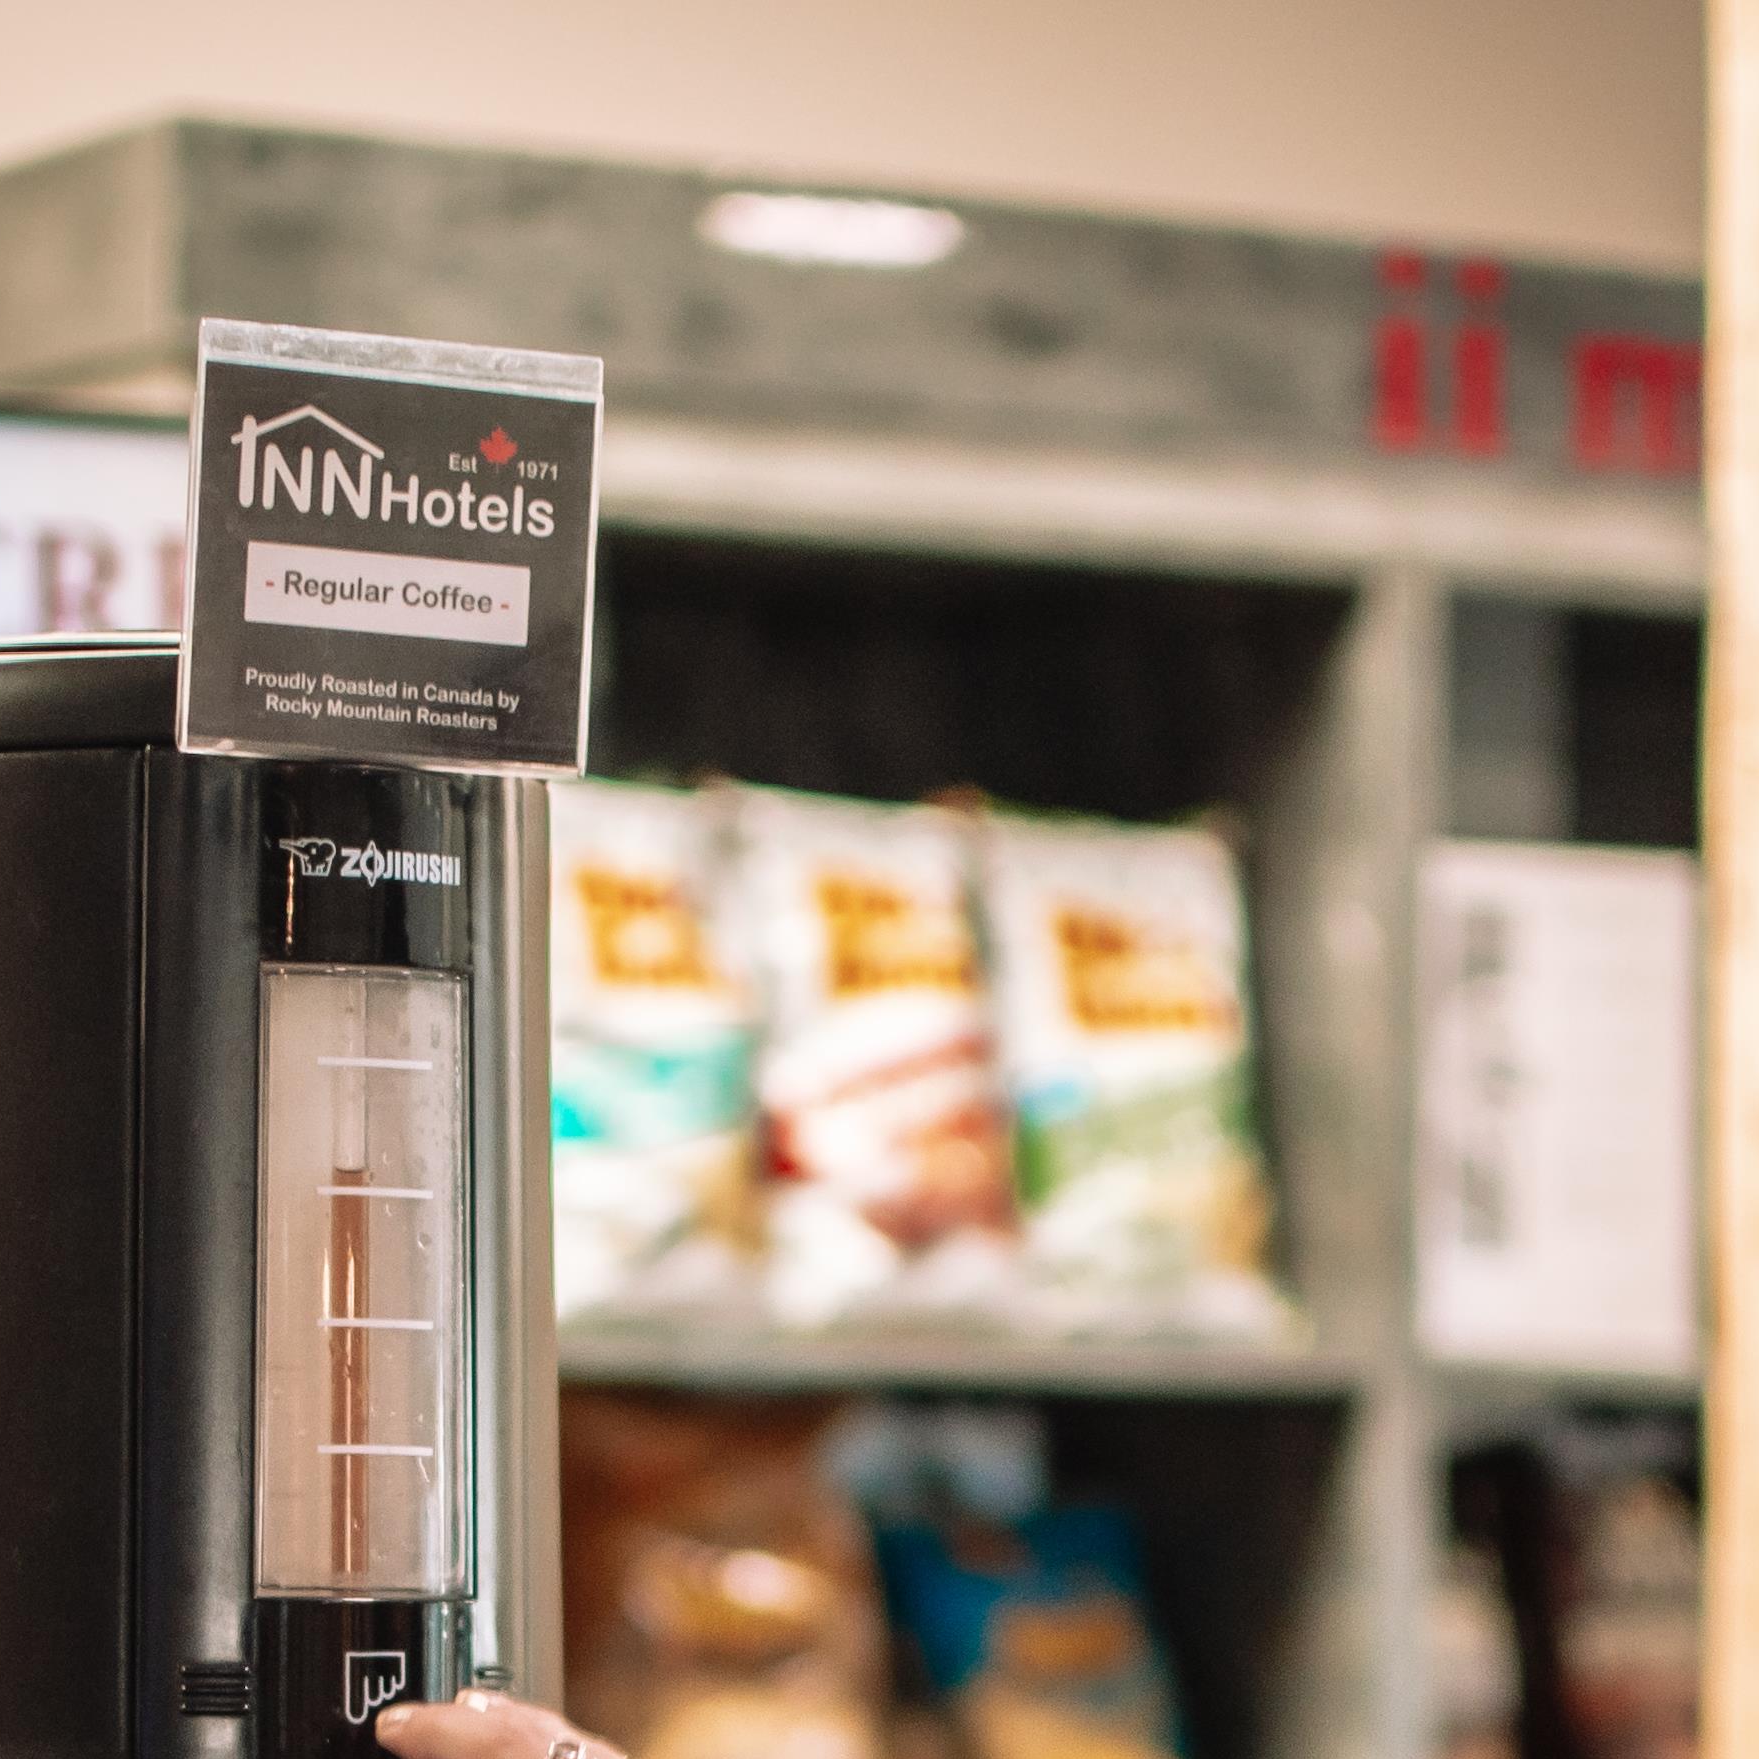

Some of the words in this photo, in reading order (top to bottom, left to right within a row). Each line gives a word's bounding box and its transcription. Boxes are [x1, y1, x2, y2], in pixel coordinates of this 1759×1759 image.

[448, 452, 479, 474] Est
[516, 459, 559, 482] 1971
[283, 570, 392, 605] Regular
[401, 583, 494, 614] Coffee
[245, 667, 317, 693] Proudly
[321, 674, 397, 698] Roasted
[401, 680, 419, 700] in
[423, 684, 494, 708] Canada
[497, 690, 520, 712] by
[265, 694, 322, 720] Rocky
[327, 699, 411, 724] Mountain
[416, 707, 498, 731] Roasters
[340, 840, 462, 888] ZOJIRUSHI
